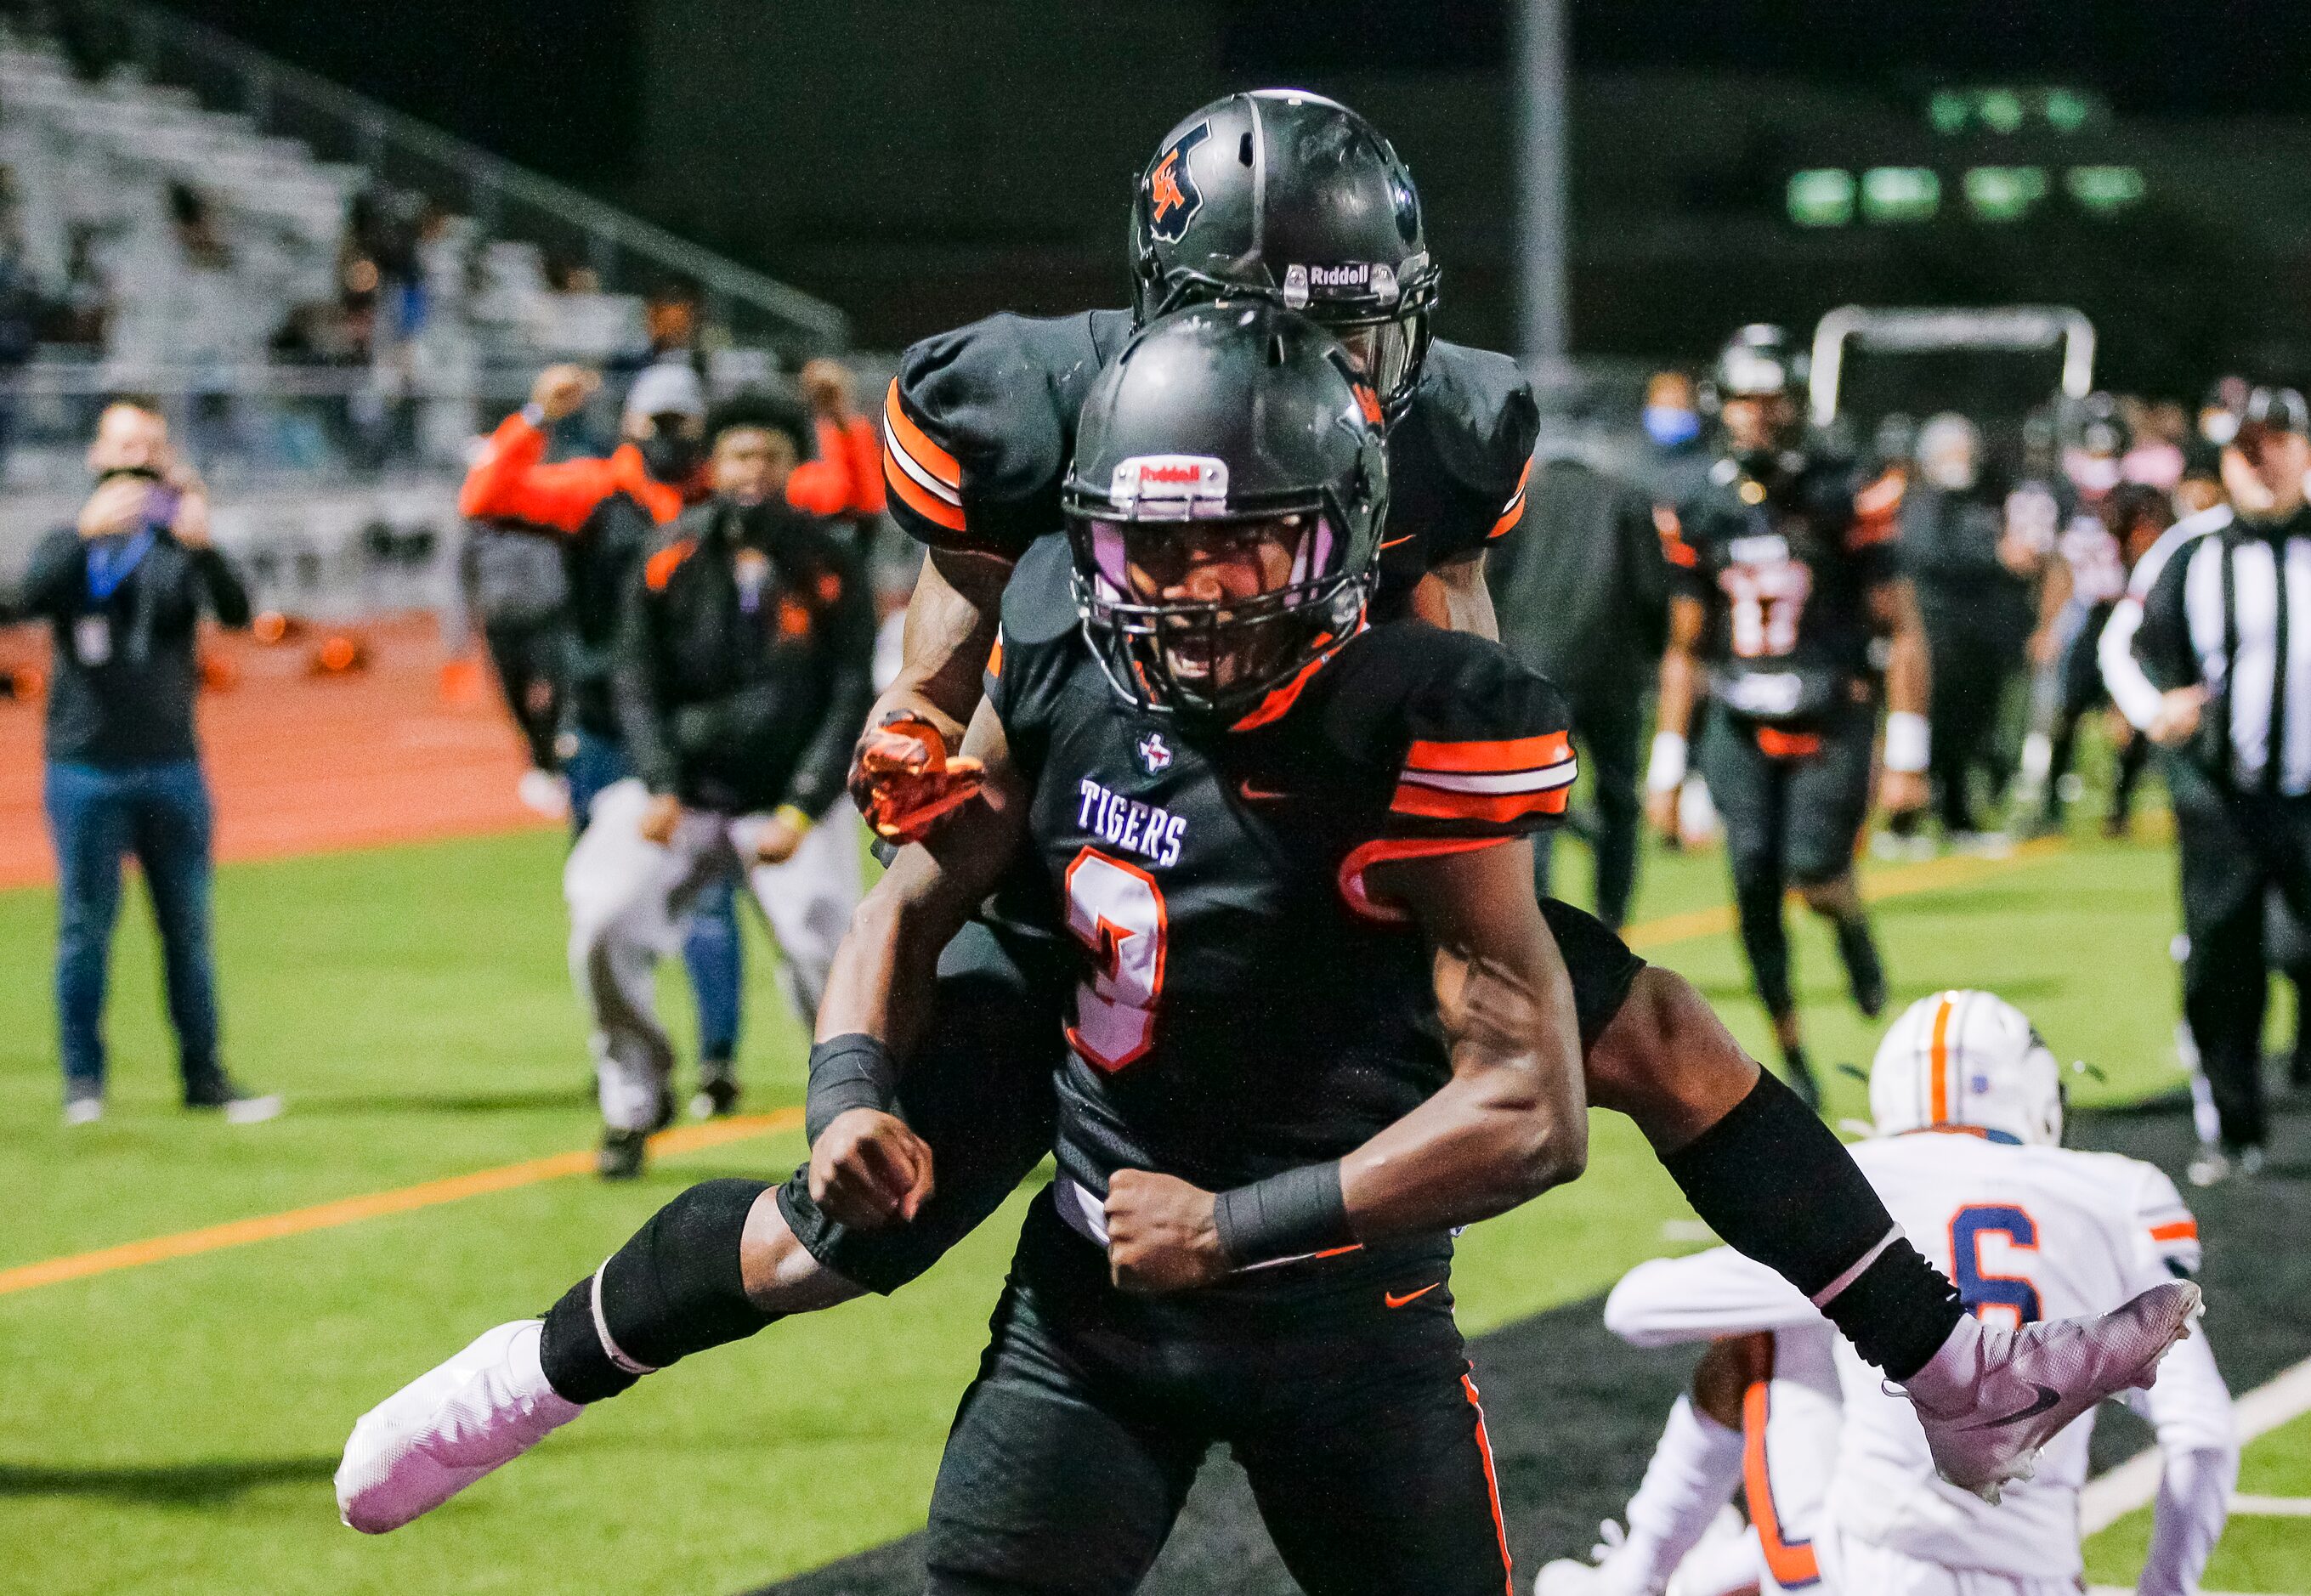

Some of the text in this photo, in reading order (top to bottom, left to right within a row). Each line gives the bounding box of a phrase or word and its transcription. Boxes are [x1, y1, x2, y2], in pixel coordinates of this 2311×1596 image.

[1311, 264, 1368, 285] Riddell
[1079, 777, 1187, 868] TIGERS
[1065, 845, 1168, 1072] 3
[1948, 1203, 2043, 1331] 6
